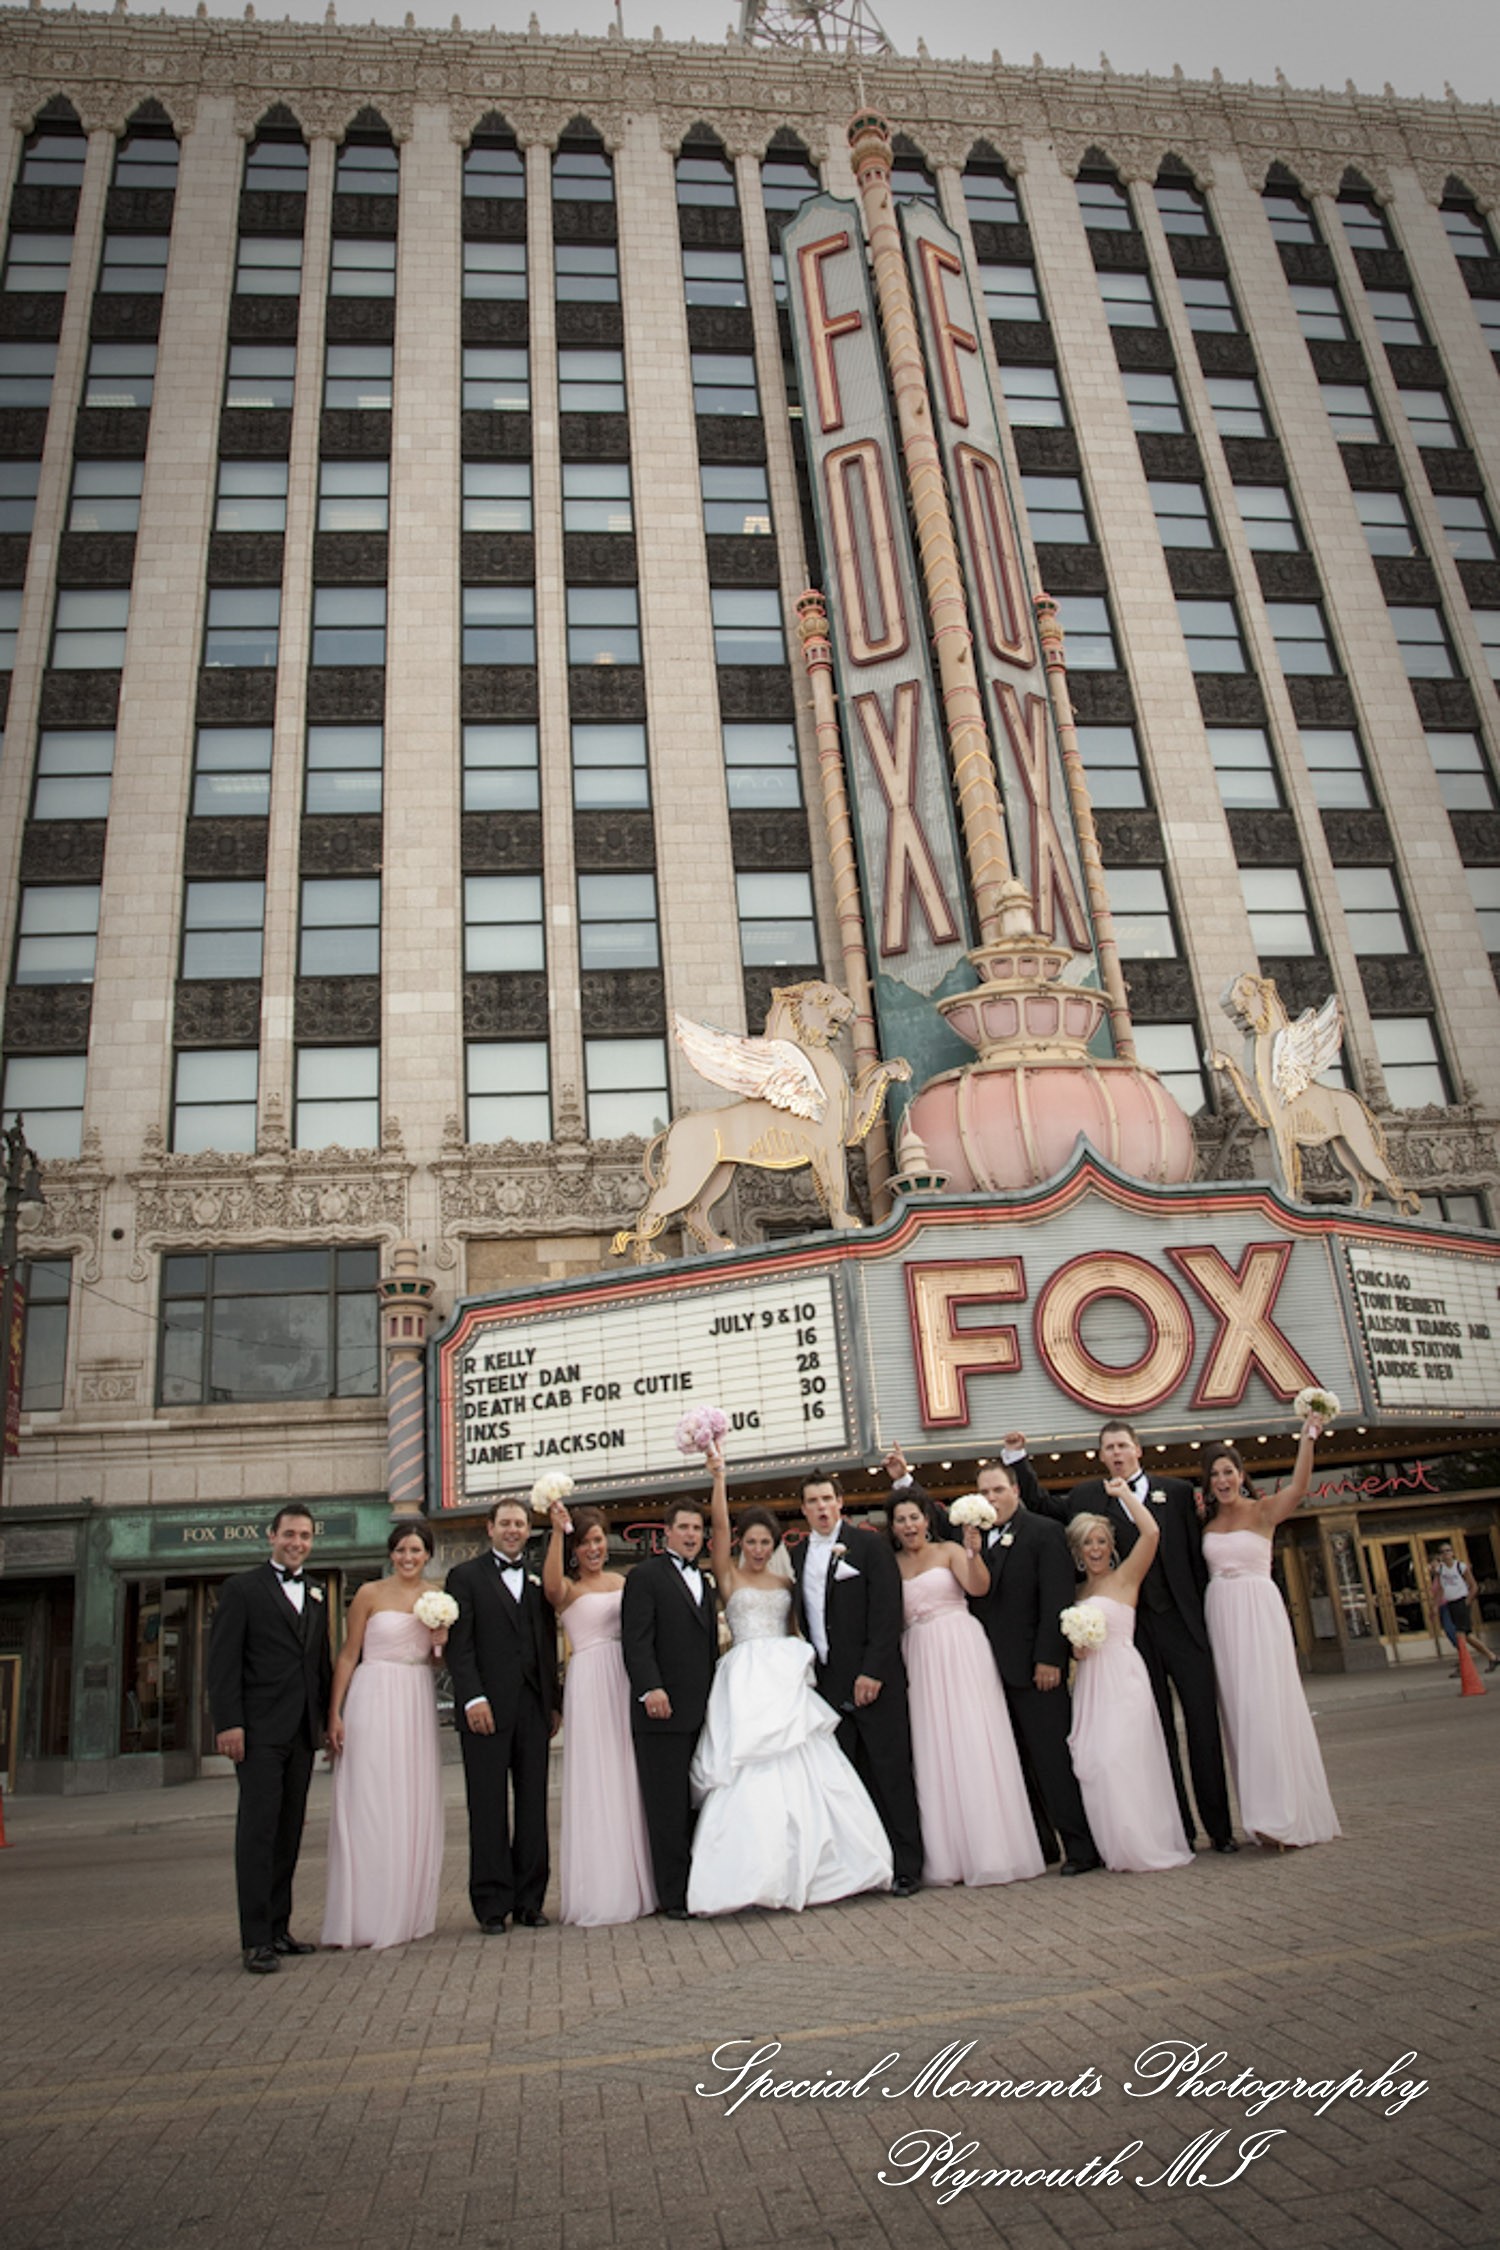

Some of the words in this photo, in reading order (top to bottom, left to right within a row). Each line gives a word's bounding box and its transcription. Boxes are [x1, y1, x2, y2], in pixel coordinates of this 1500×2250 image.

[799, 230, 960, 958] FOX
[917, 235, 1092, 954] FOX
[1356, 1270, 1411, 1290] CHICAGO
[1360, 1292, 1392, 1310] TONY
[1395, 1295, 1447, 1315] BENNETT
[464, 1358, 476, 1374] R
[484, 1347, 537, 1372] KELLY
[709, 1312, 755, 1336] JULY
[794, 1303, 816, 1323] 10
[904, 1241, 1325, 1429] FOX
[1367, 1315, 1412, 1333] ALISON
[1416, 1319, 1462, 1338] KRAUSS
[1467, 1323, 1491, 1340] AND
[1370, 1337, 1409, 1355] UNION
[1411, 1340, 1462, 1359] STATION
[464, 1372, 528, 1396] STEELY
[539, 1364, 581, 1387] DAN
[796, 1327, 817, 1347] 16
[464, 1395, 526, 1419] DEATH
[532, 1389, 573, 1410] CAB
[581, 1382, 621, 1403] FOR
[633, 1371, 693, 1396] CUTIE
[796, 1351, 820, 1372] 28
[1377, 1360, 1420, 1378] ANDRE
[1423, 1362, 1453, 1380] RIEU
[466, 1421, 511, 1442] INXS
[800, 1376, 826, 1396] 30
[466, 1442, 525, 1465] JANET
[533, 1429, 625, 1457] JACKSON
[728, 1410, 760, 1432] UG
[803, 1400, 825, 1422] 16
[183, 1527, 216, 1542] FOX
[224, 1524, 259, 1540] BOX
